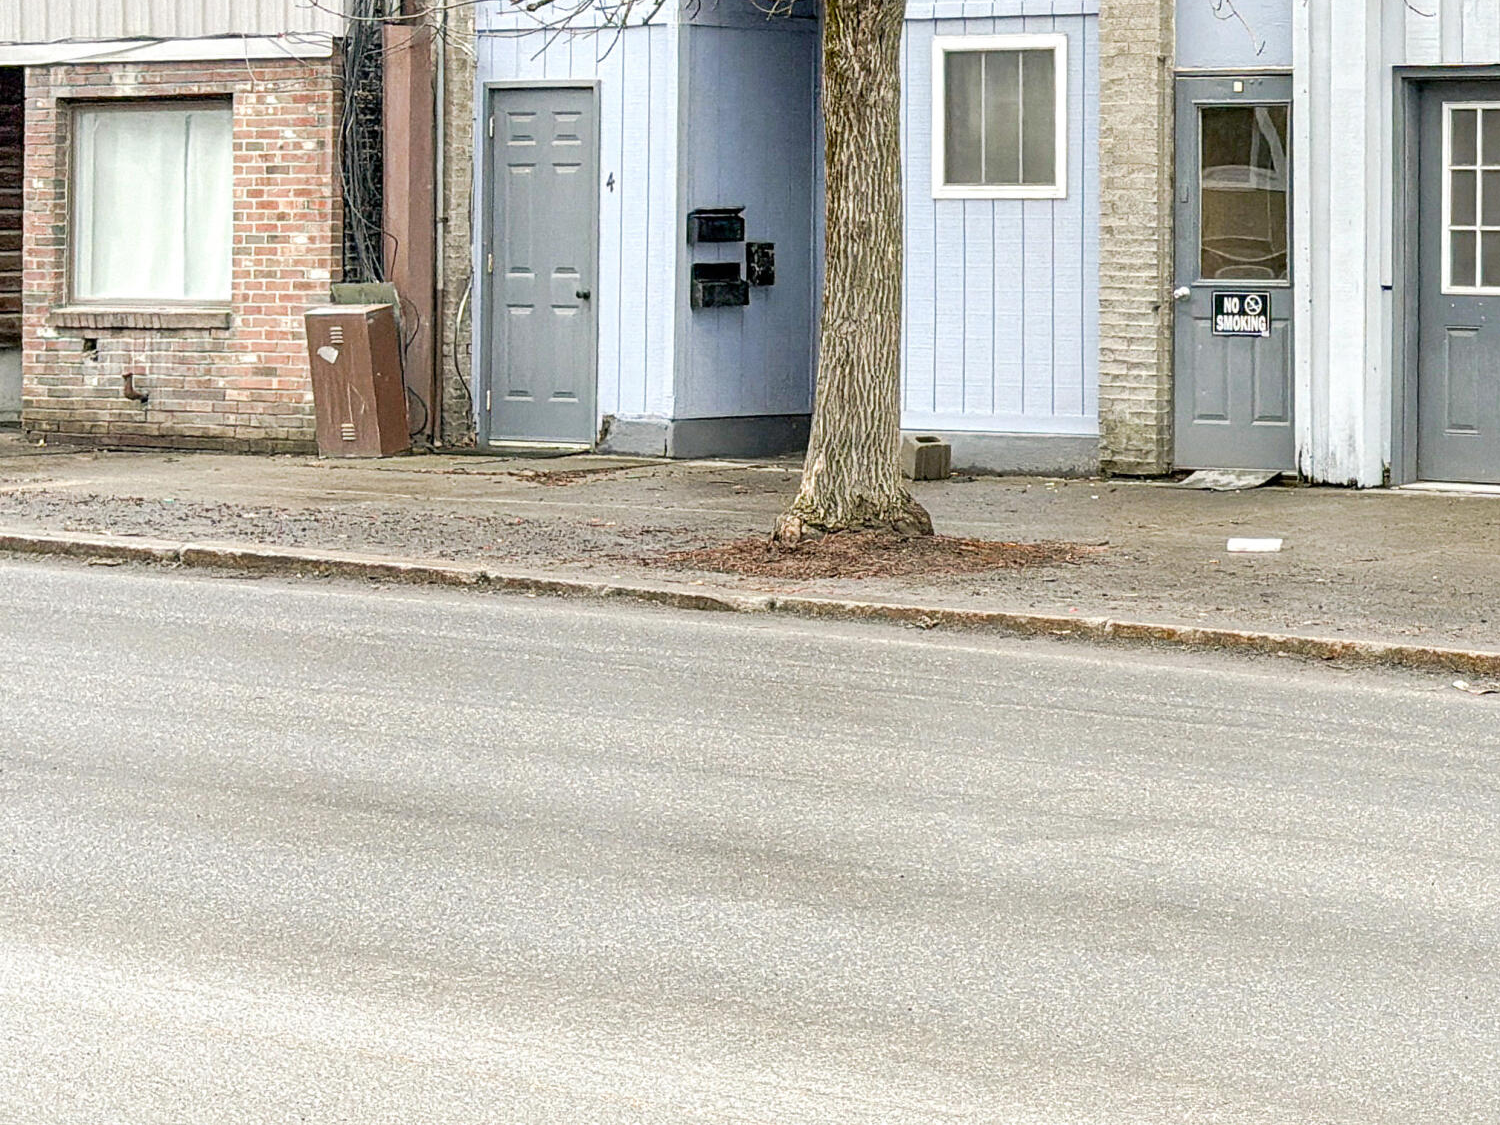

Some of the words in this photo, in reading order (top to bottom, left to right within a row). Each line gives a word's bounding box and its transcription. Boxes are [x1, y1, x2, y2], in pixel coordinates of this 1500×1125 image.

[606, 171, 616, 193] 4
[1223, 297, 1240, 314] NO
[1216, 314, 1266, 332] SMOKING
